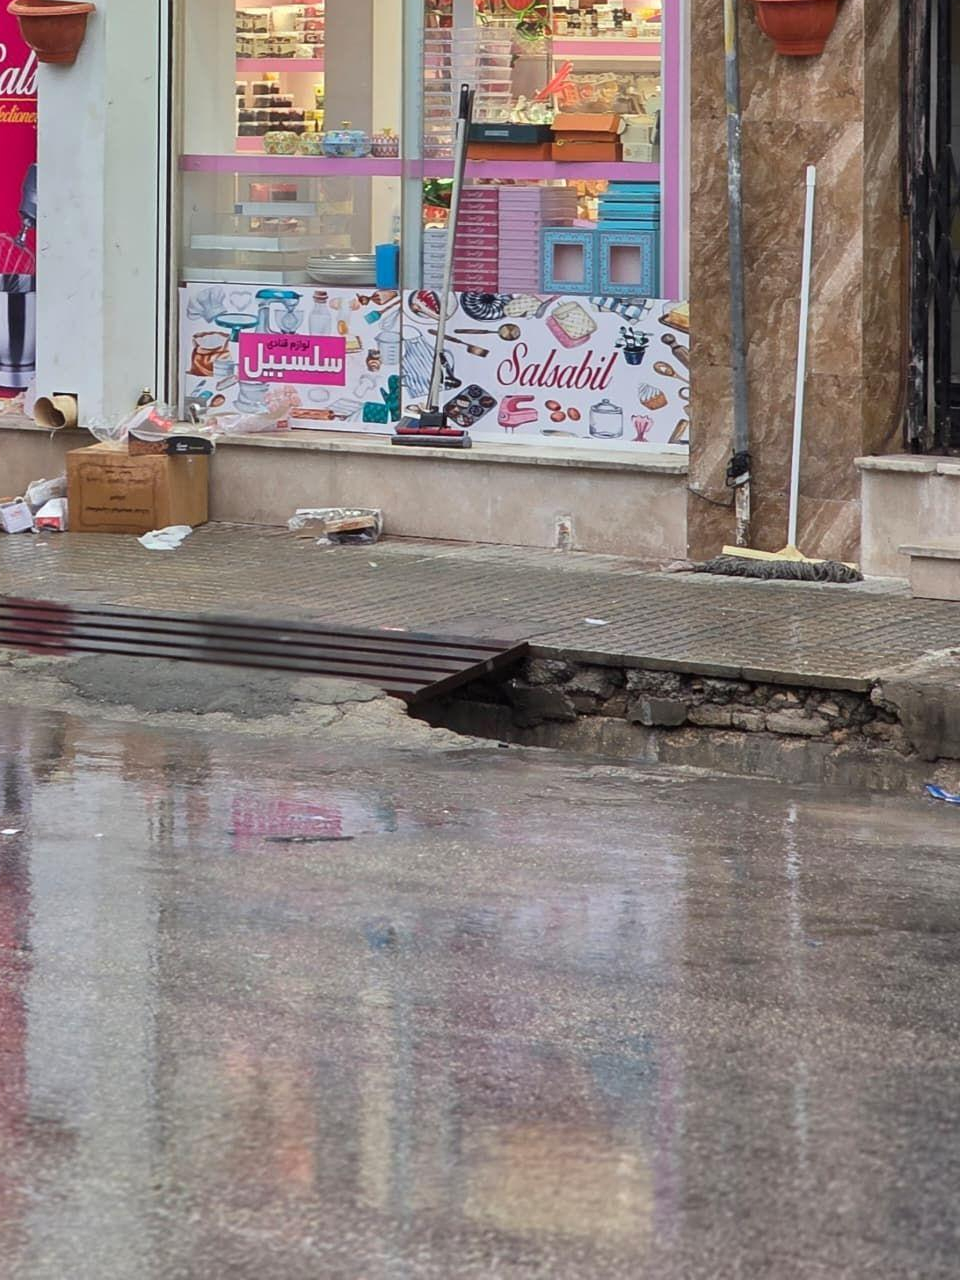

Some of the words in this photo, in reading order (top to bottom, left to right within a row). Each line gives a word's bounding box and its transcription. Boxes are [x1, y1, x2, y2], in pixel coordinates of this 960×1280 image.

[244, 342, 343, 379] سلسبیل
[290, 340, 311, 352] لوازم
[496, 342, 618, 390] Salsabil
